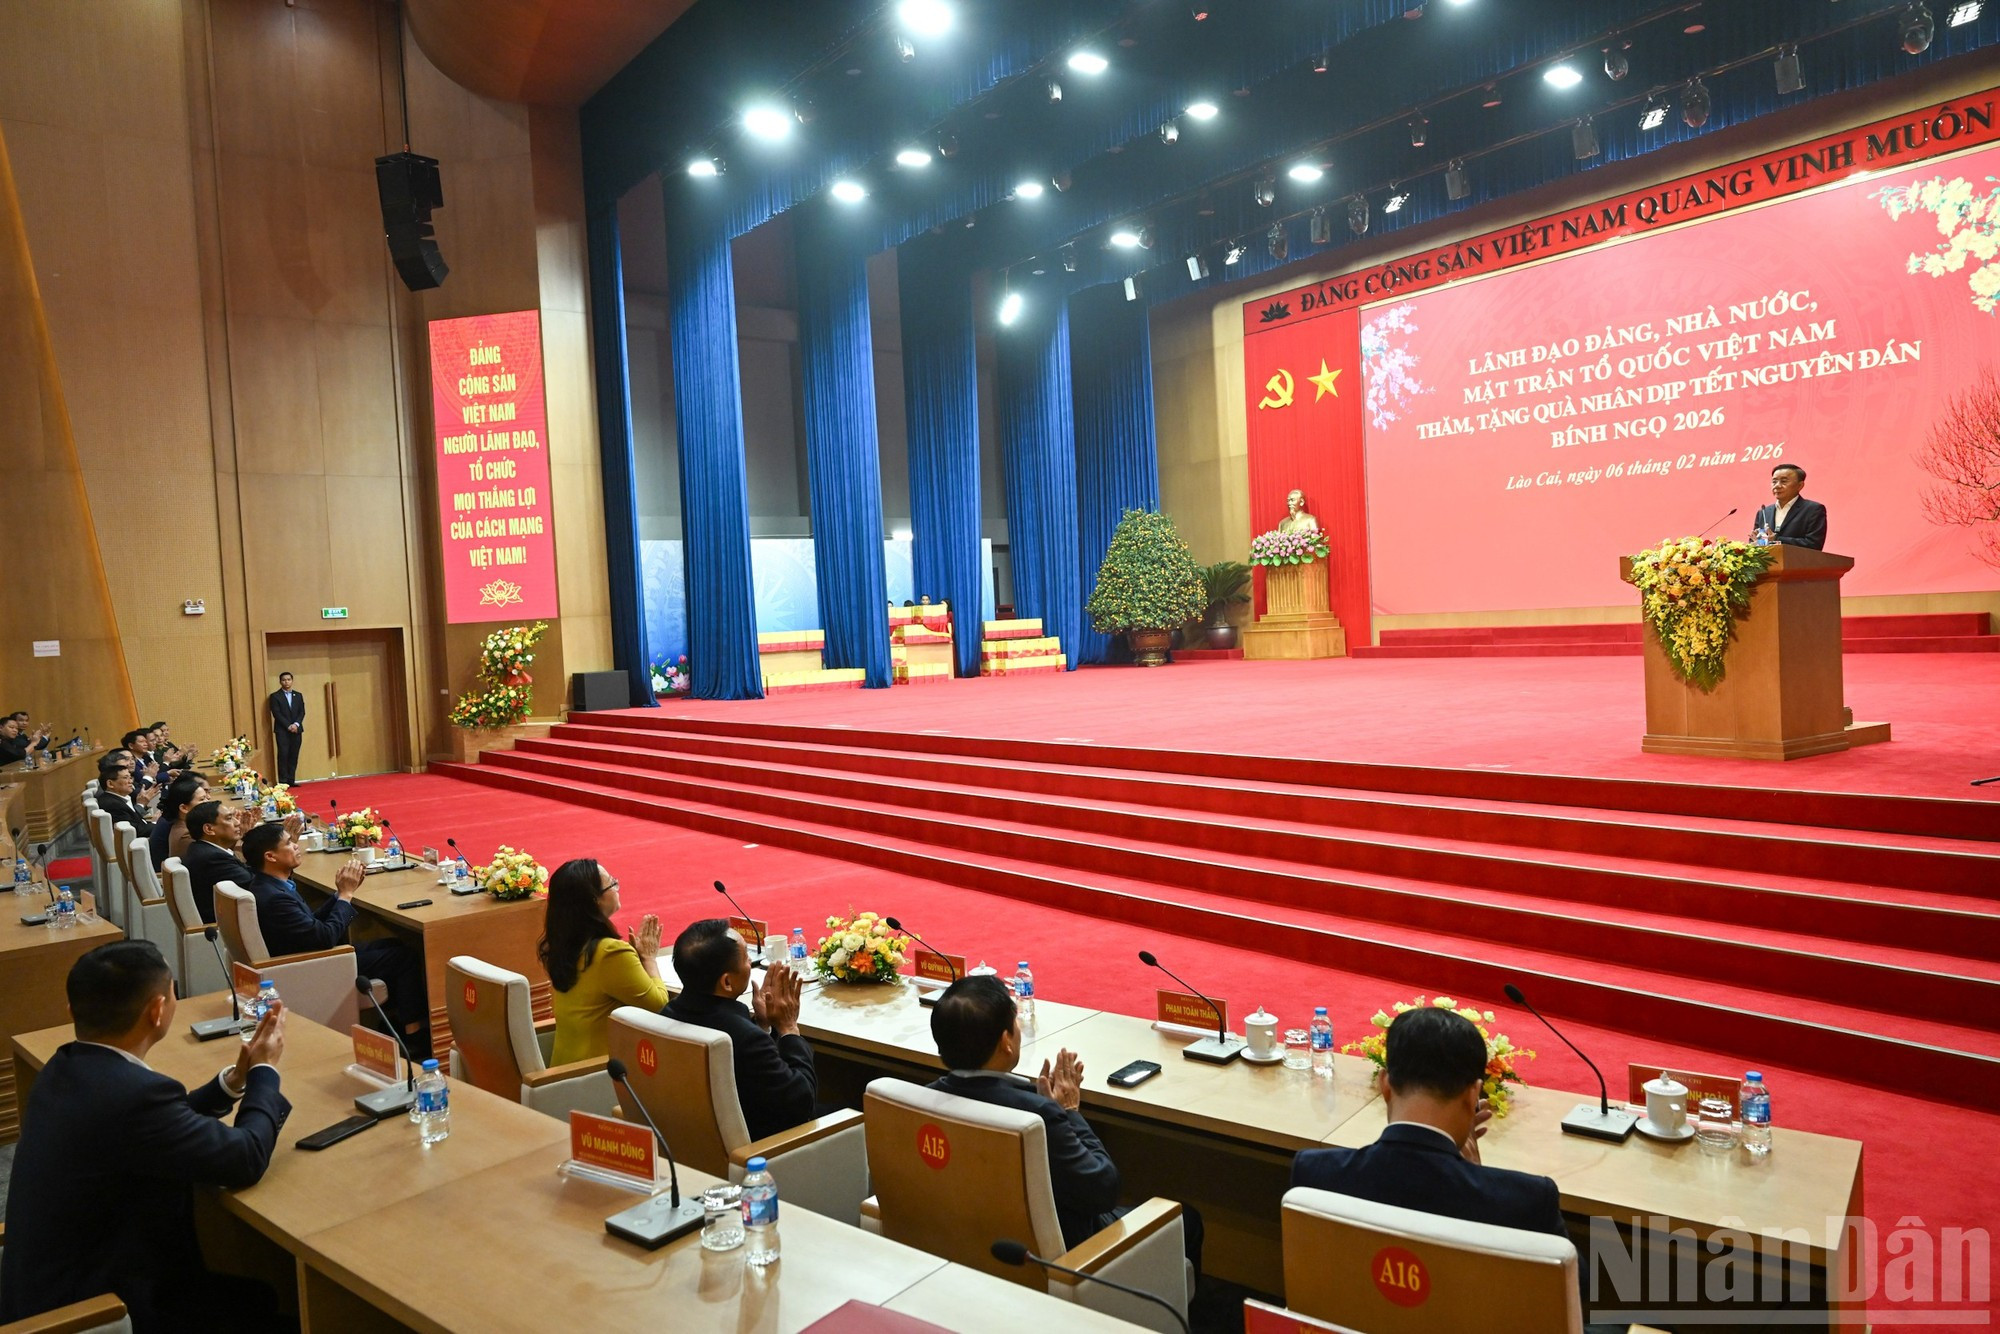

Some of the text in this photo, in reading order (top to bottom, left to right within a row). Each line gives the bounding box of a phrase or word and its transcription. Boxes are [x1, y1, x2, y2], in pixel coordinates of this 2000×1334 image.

[1301, 102, 1993, 312] ĐẢNG CỘNG SẢN VIỆT NAM QUANG VINH MUÔN
[1469, 289, 1818, 376] LÃNH ĐẠO ĐẢNG, NHÀ NƯỚC,
[470, 340, 500, 366] ĐẢNG
[1463, 320, 1836, 404] MẶT TRẬN TỔ QUỐC VIỆT NAM
[459, 367, 516, 396] CỘNG SẢN
[1416, 339, 1922, 440] THĂM, TẶNG QUÀ NHÂN DỊP TẾT NGUYÊN ĐÁN
[463, 403, 515, 426] VIỆT NAM
[1551, 407, 1725, 448] BÍNH NGỌ 2026
[444, 430, 539, 454] NGƯỜI LÃNH ĐẠO,
[469, 456, 516, 481] TỔ CHỨC
[1506, 442, 1785, 490] Lào Cai, ngày 06 tháng 02 năm 2026
[454, 487, 536, 512] MỌI THẮNG LỢI
[450, 515, 543, 540] CỦA CÁCH MẠNG
[469, 546, 526, 569] VIỆT NAM!
[1166, 1004, 1219, 1020] PHẠM TOÀN THẮNG
[640, 1046, 654, 1067] A14
[581, 1132, 645, 1161] VŨ MẠNH DŨNG
[923, 1133, 944, 1160] A15
[1380, 1257, 1420, 1291] A16
